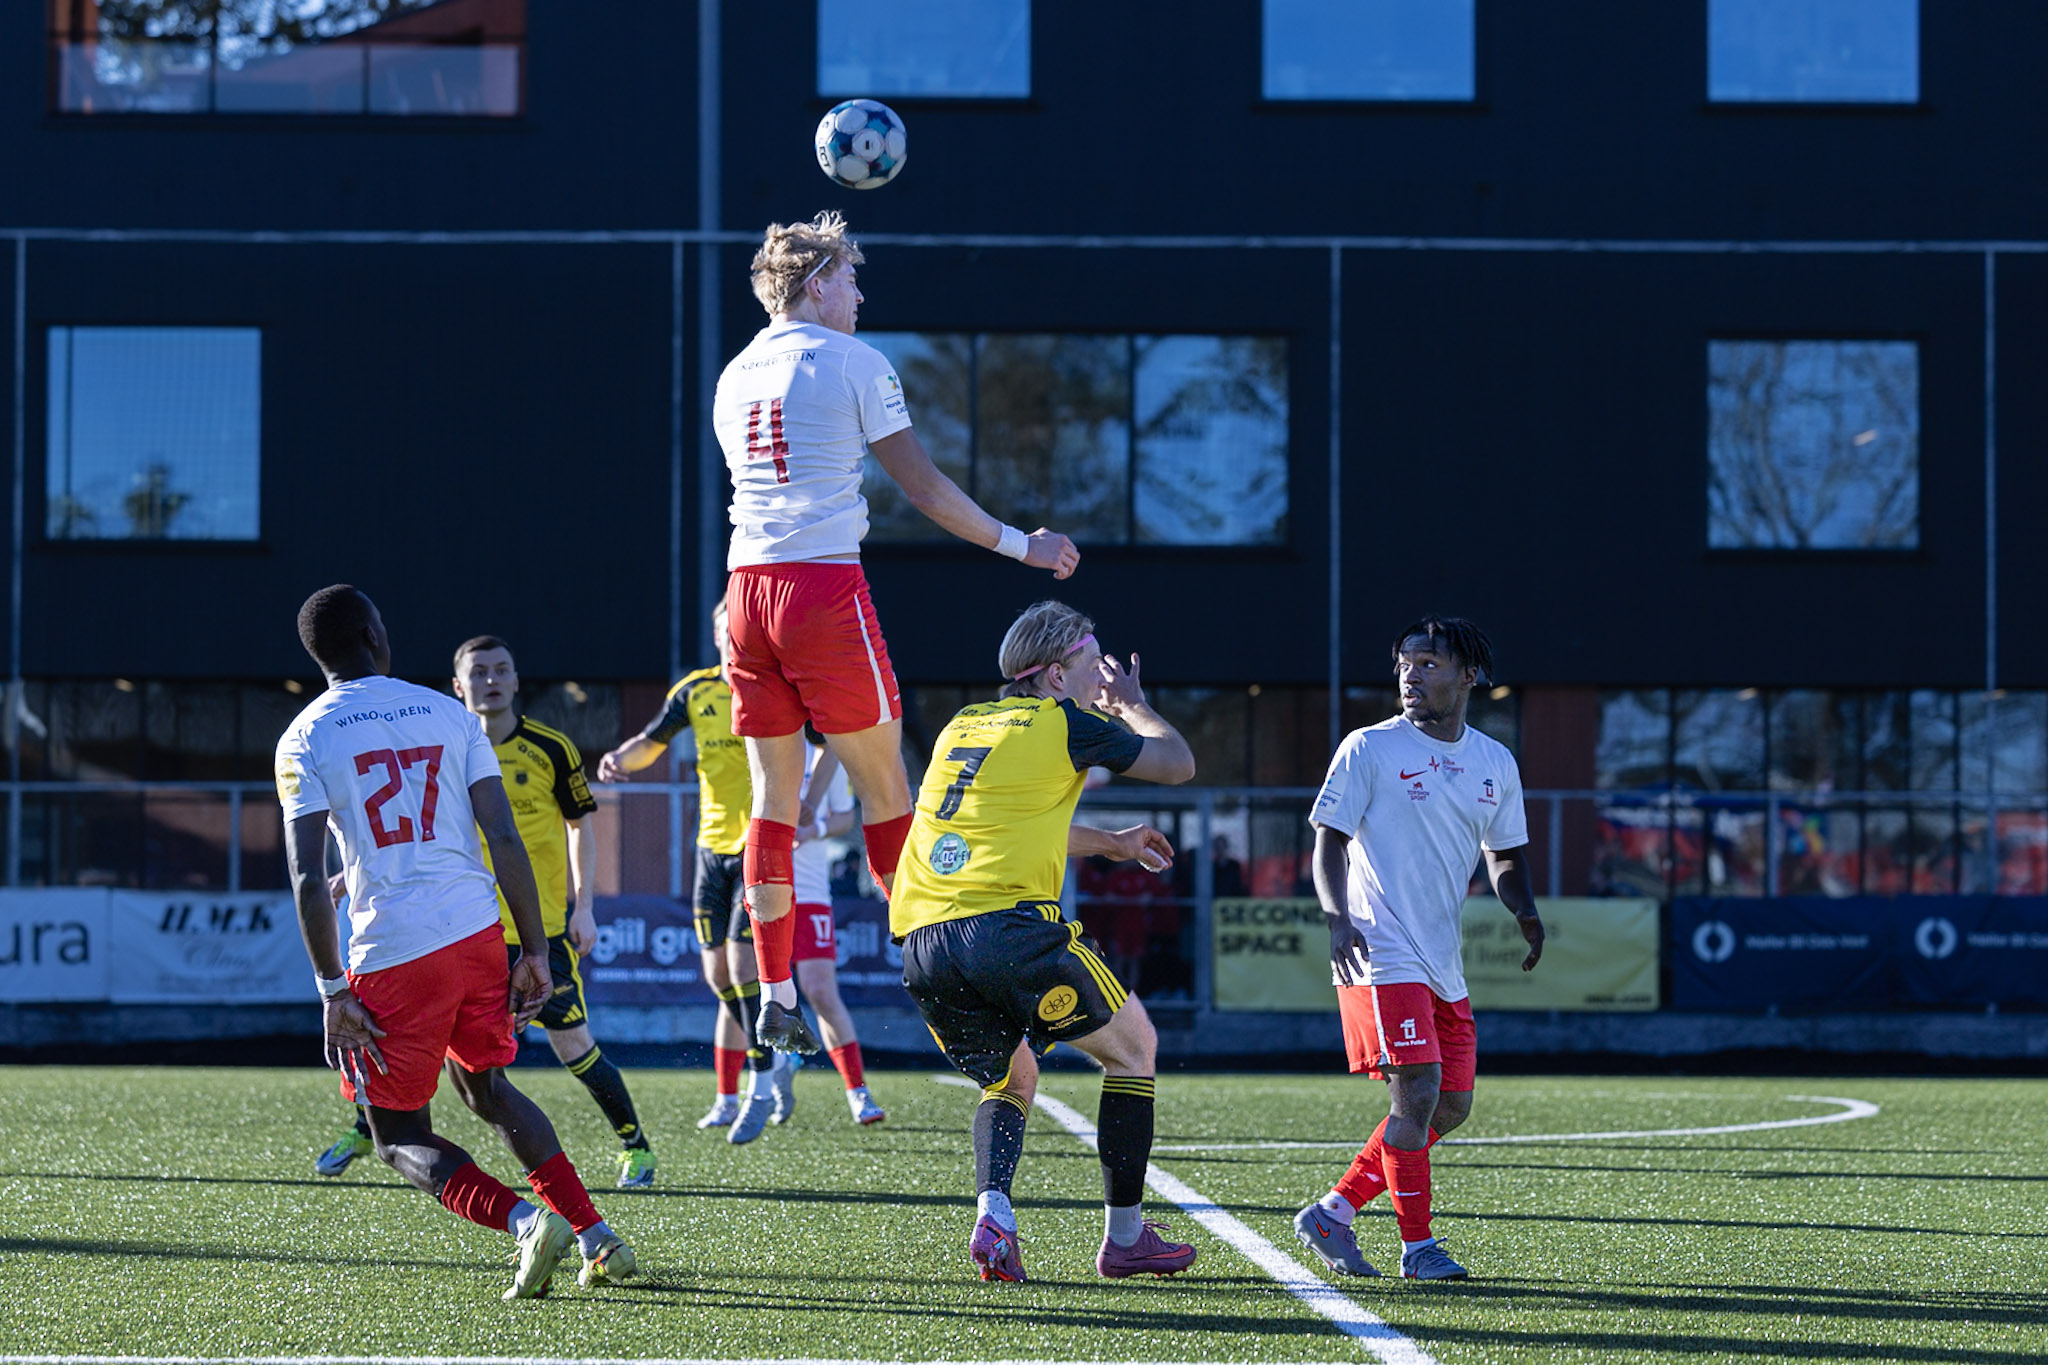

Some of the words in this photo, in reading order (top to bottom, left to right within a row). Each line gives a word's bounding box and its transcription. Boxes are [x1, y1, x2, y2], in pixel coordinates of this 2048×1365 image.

[747, 398, 790, 484] 4
[335, 710, 394, 728] WIKBOG
[399, 705, 432, 718] REIN
[527, 749, 551, 771] OBOS
[353, 745, 445, 849] 27
[935, 747, 993, 821] 7
[809, 913, 831, 941] 17
[1220, 933, 1304, 956] SPACE
